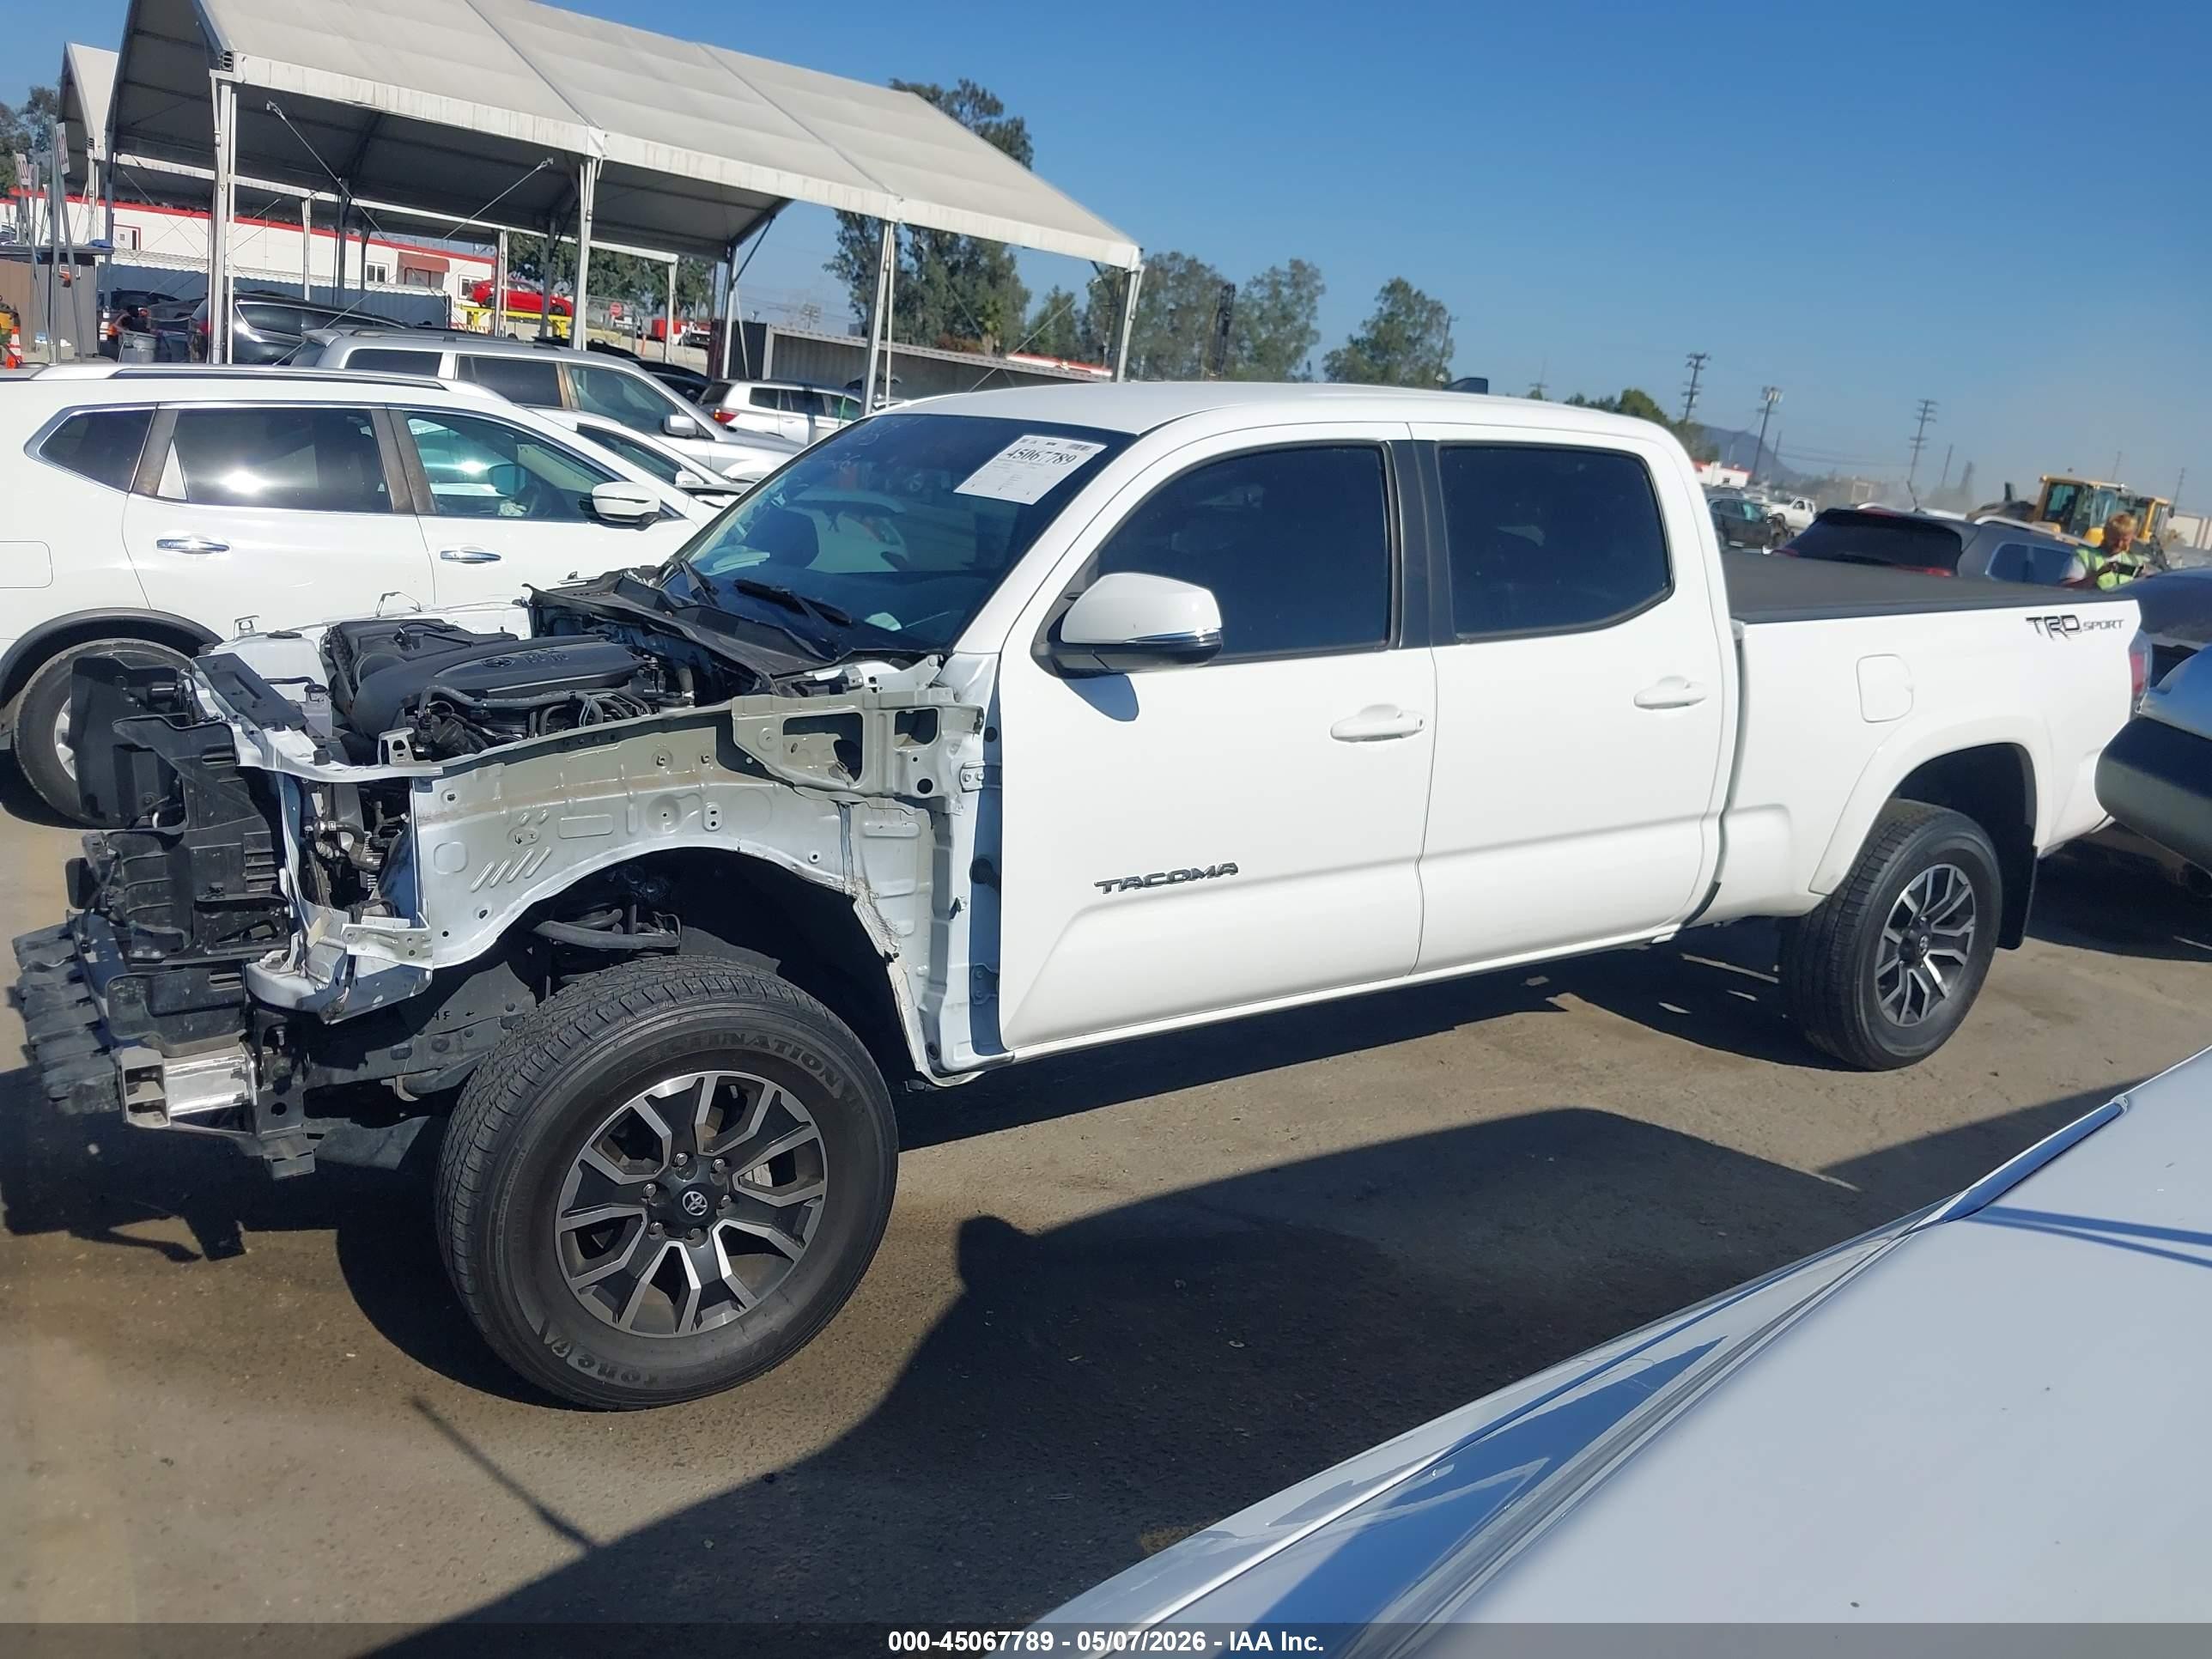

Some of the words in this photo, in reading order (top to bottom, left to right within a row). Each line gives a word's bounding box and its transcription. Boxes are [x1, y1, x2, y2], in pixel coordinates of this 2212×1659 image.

[1006, 448, 1077, 465] 45067789
[2026, 614, 2081, 641] TRD
[2082, 619, 2124, 631] SPORT
[1094, 862, 1239, 894] TACOMA
